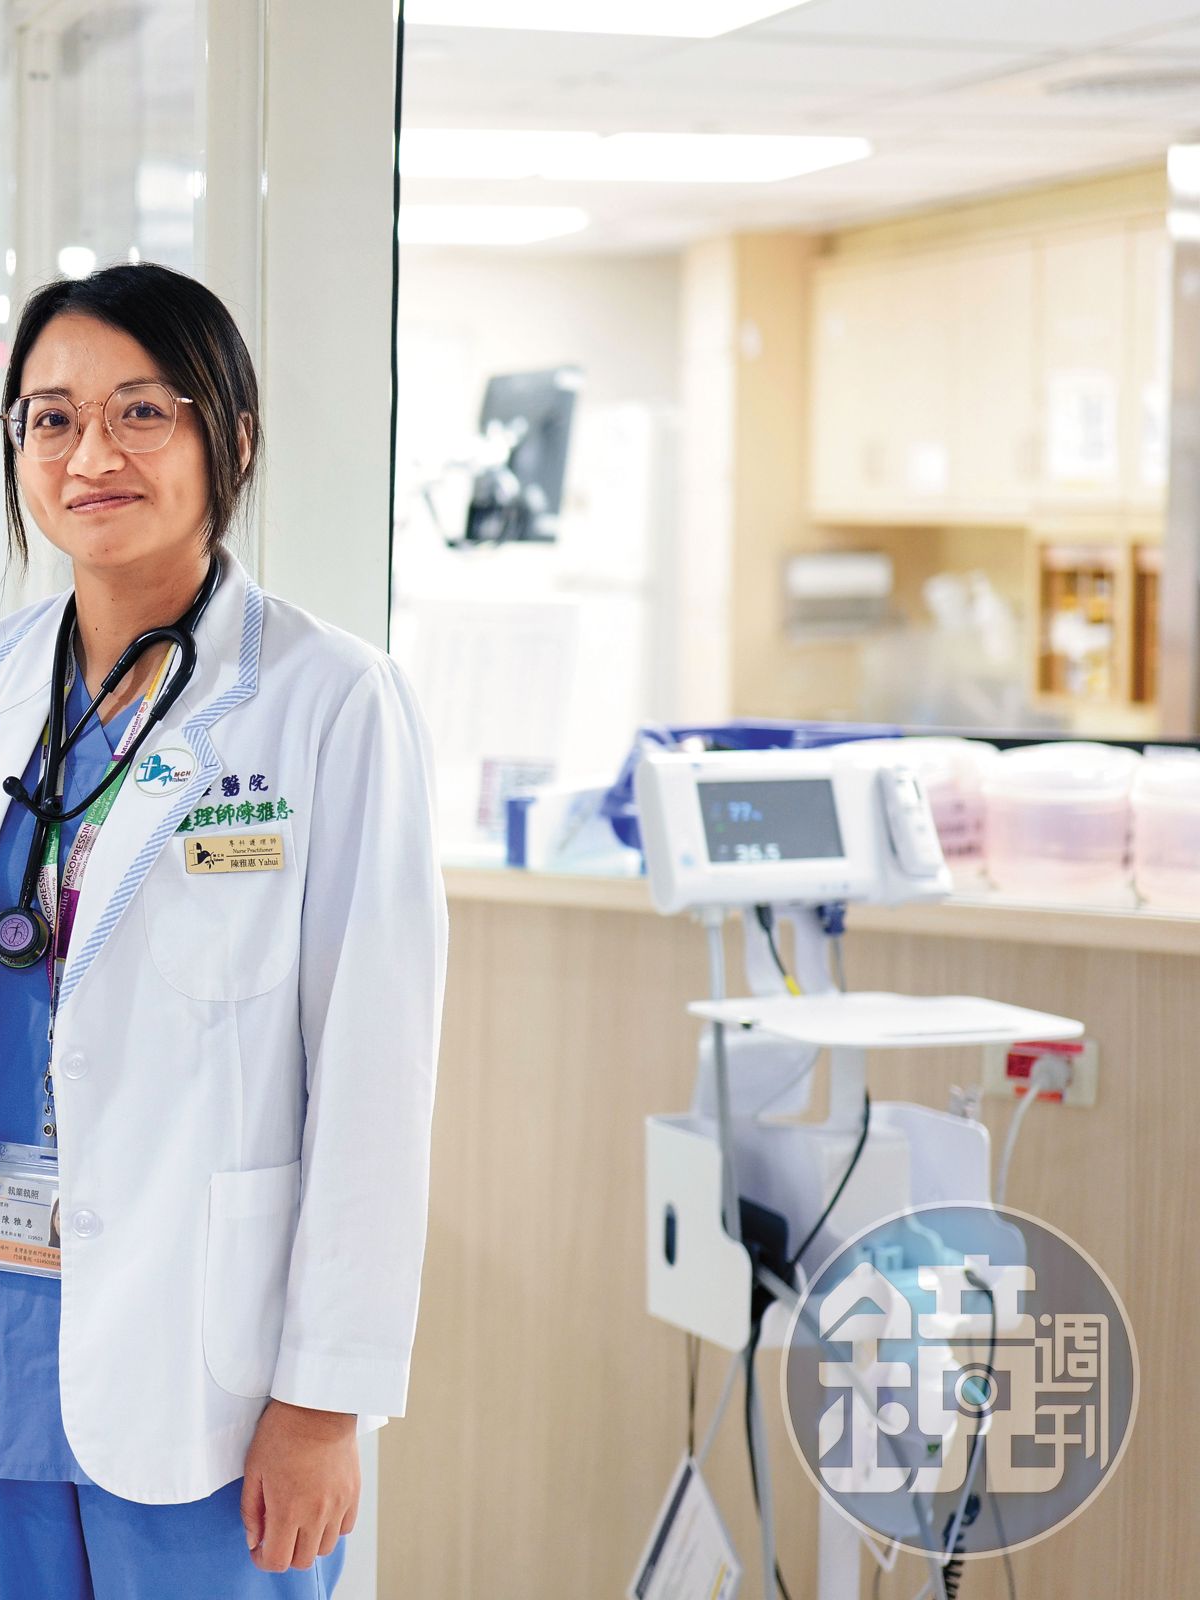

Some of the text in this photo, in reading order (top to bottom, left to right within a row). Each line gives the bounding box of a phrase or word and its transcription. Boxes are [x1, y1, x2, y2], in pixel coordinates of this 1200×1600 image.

[202, 774, 269, 797] 醫院
[63, 823, 92, 888] VASOPRESSIN
[230, 857, 279, 869] 陳雅惠 Yahui
[8, 1186, 39, 1199] 執業執照
[1, 1215, 33, 1229] 陳雅惠
